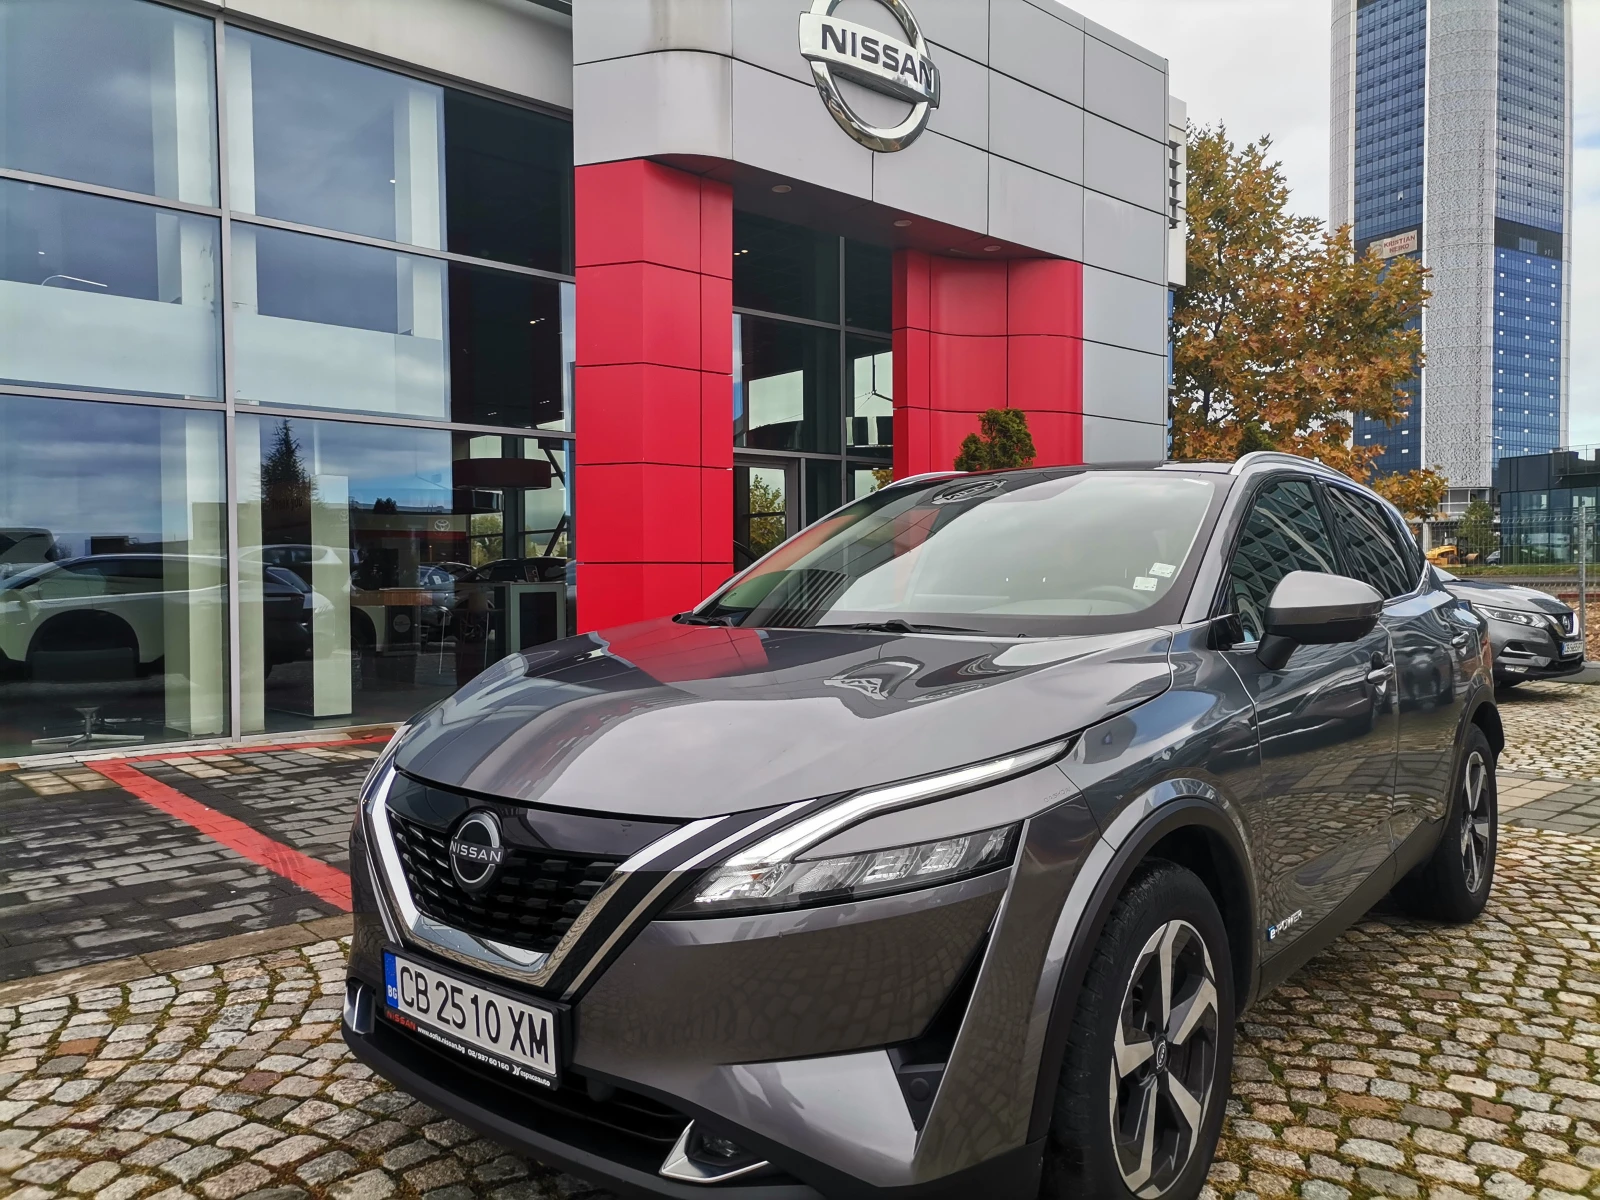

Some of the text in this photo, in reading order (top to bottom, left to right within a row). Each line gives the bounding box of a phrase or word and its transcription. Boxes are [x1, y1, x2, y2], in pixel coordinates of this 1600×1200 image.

[821, 23, 935, 93] NISSAN
[1383, 234, 1416, 248] KRISTIAN
[449, 840, 502, 863] NISSAN
[387, 984, 398, 1000] BG
[400, 965, 549, 1065] CB 2510 XM
[386, 1010, 417, 1031] NISSAN
[417, 1026, 466, 1054] www.sofia.nissan.bg
[520, 1069, 551, 1087] espaceauto
